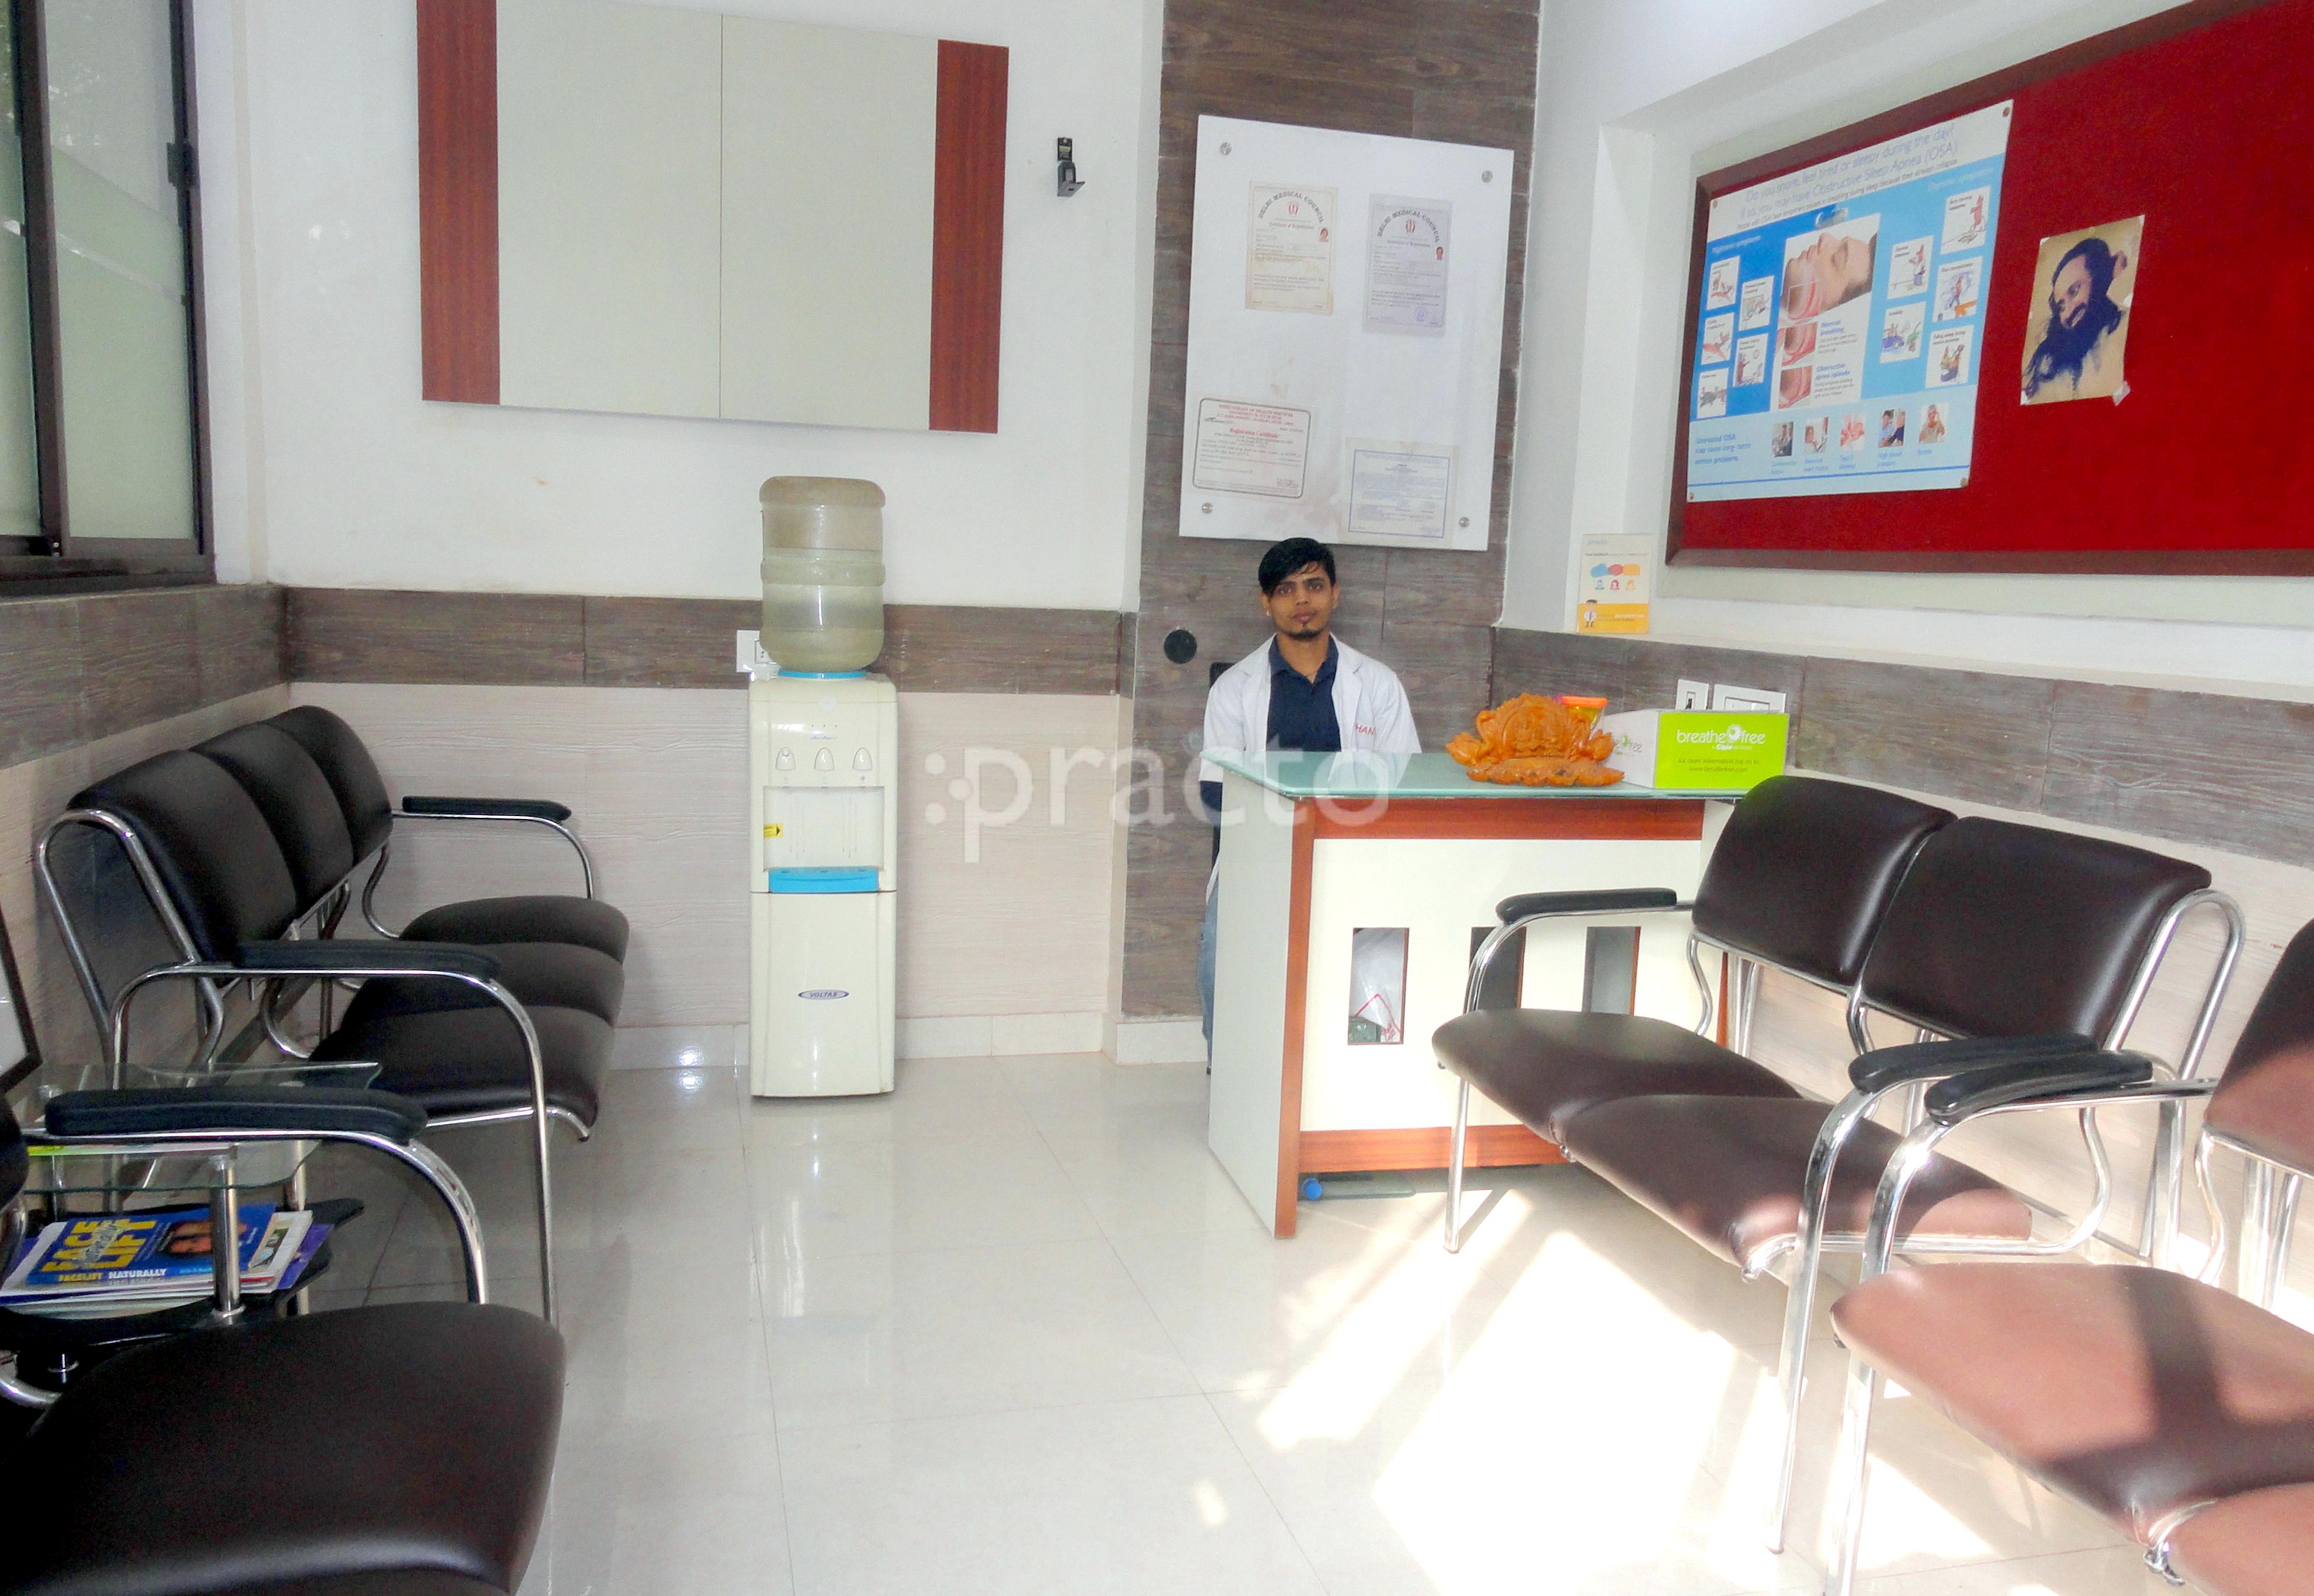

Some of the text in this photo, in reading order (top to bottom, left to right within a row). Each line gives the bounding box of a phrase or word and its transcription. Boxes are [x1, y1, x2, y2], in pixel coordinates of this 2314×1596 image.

[1924, 138, 1959, 165] (OSA)
[1273, 190, 1303, 201] MEDICAL
[1304, 196, 1325, 224] COUNCIL
[1391, 209, 1421, 219] MEDICAL
[1421, 214, 1440, 243] COUNCIL
[1676, 729, 1766, 745] breathe free
[108, 1268, 167, 1280] NATURALLY
